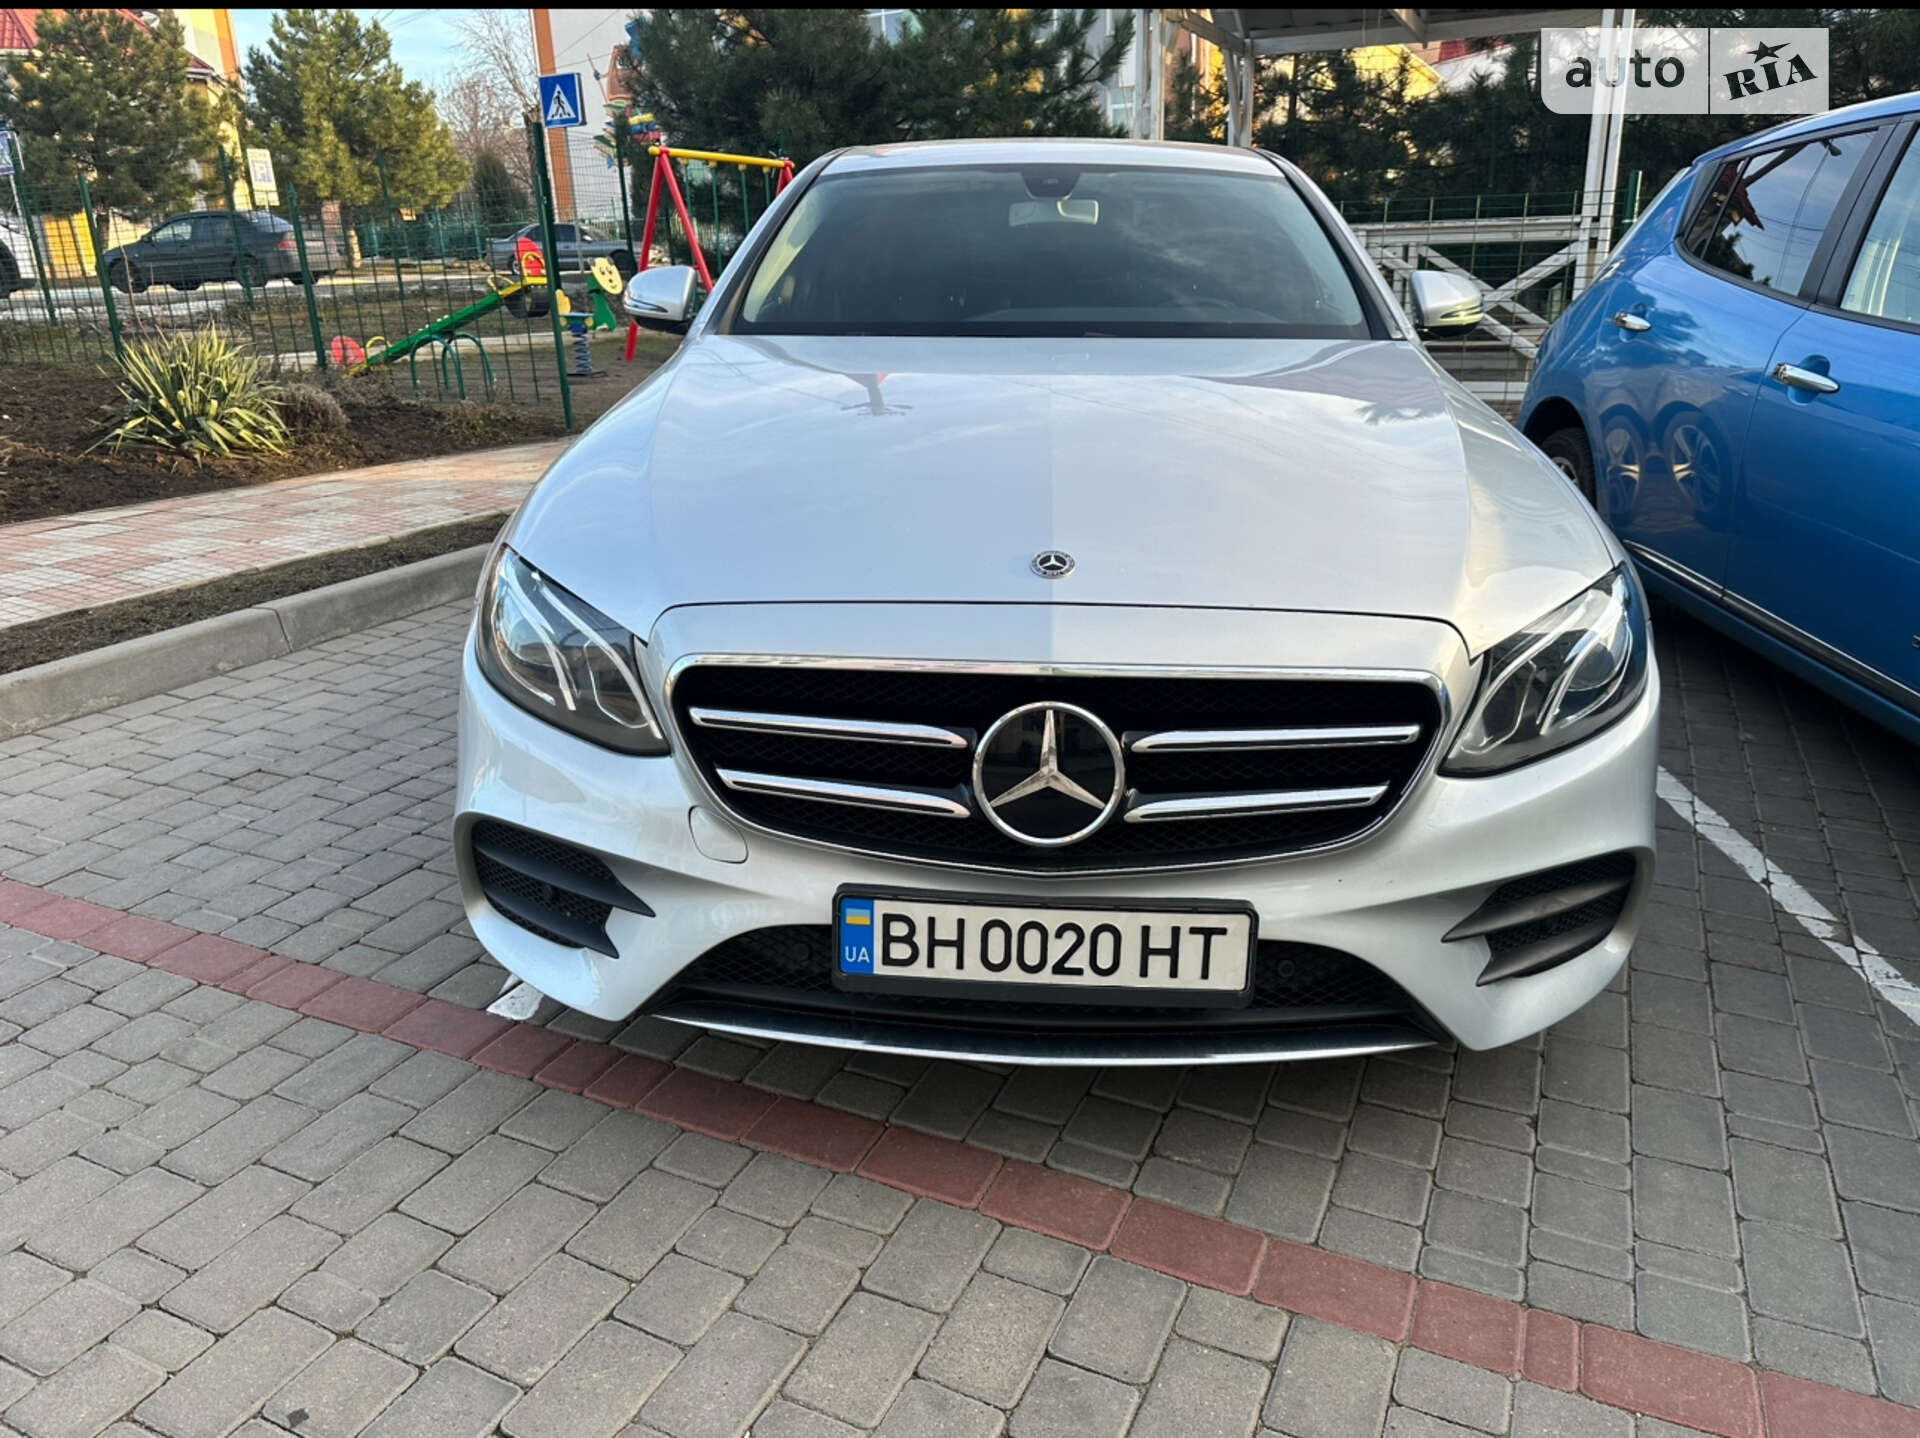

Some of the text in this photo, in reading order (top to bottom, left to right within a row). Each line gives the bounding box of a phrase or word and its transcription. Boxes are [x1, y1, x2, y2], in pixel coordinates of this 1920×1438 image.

[844, 945, 870, 963] UA
[881, 912, 1229, 981] BH 0020 HT
